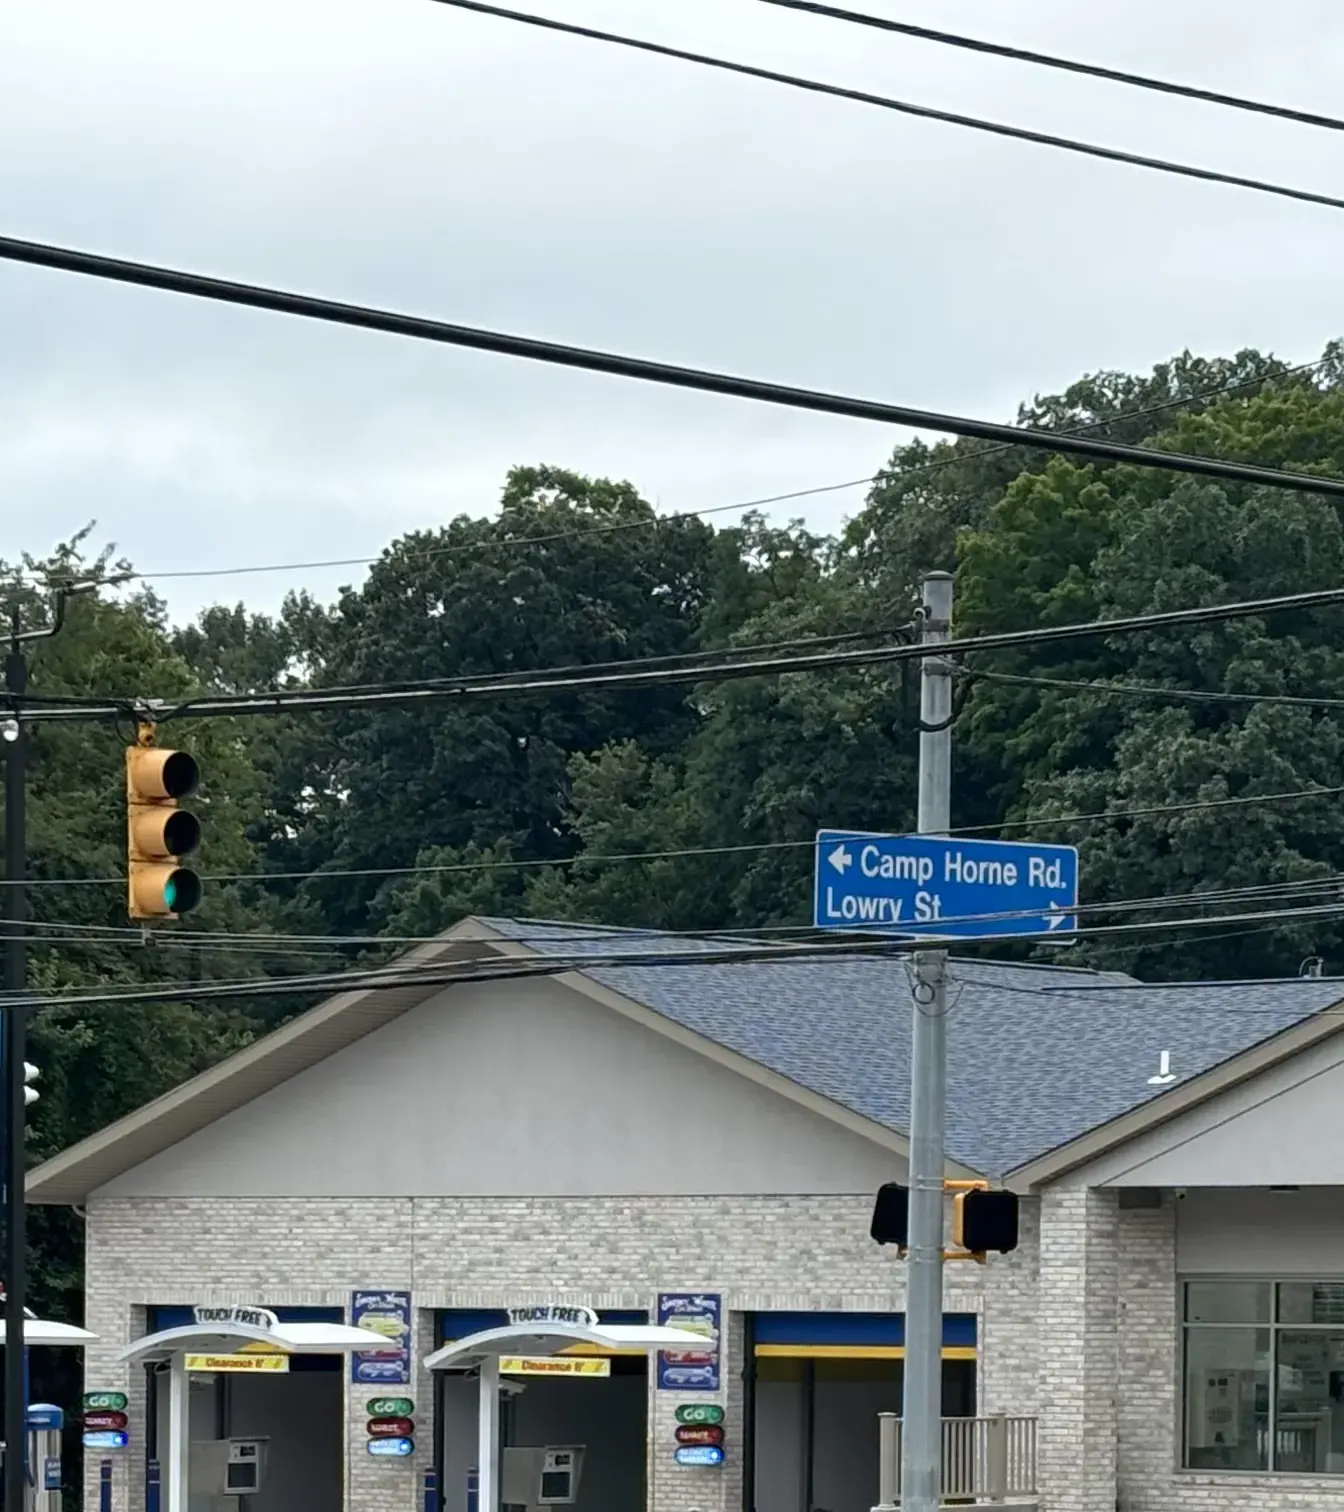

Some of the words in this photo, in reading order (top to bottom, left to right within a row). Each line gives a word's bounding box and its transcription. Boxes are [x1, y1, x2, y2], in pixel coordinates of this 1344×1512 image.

[861, 845, 933, 886] Camp
[945, 851, 1017, 886] Horne
[1028, 857, 1067, 889] Rd.
[826, 887, 903, 922] Lowry
[914, 891, 942, 921] St
[197, 1307, 233, 1321] TOUCH
[510, 1306, 549, 1321] TOUCH
[553, 1306, 579, 1323] FREE
[205, 1357, 253, 1369] Clearance
